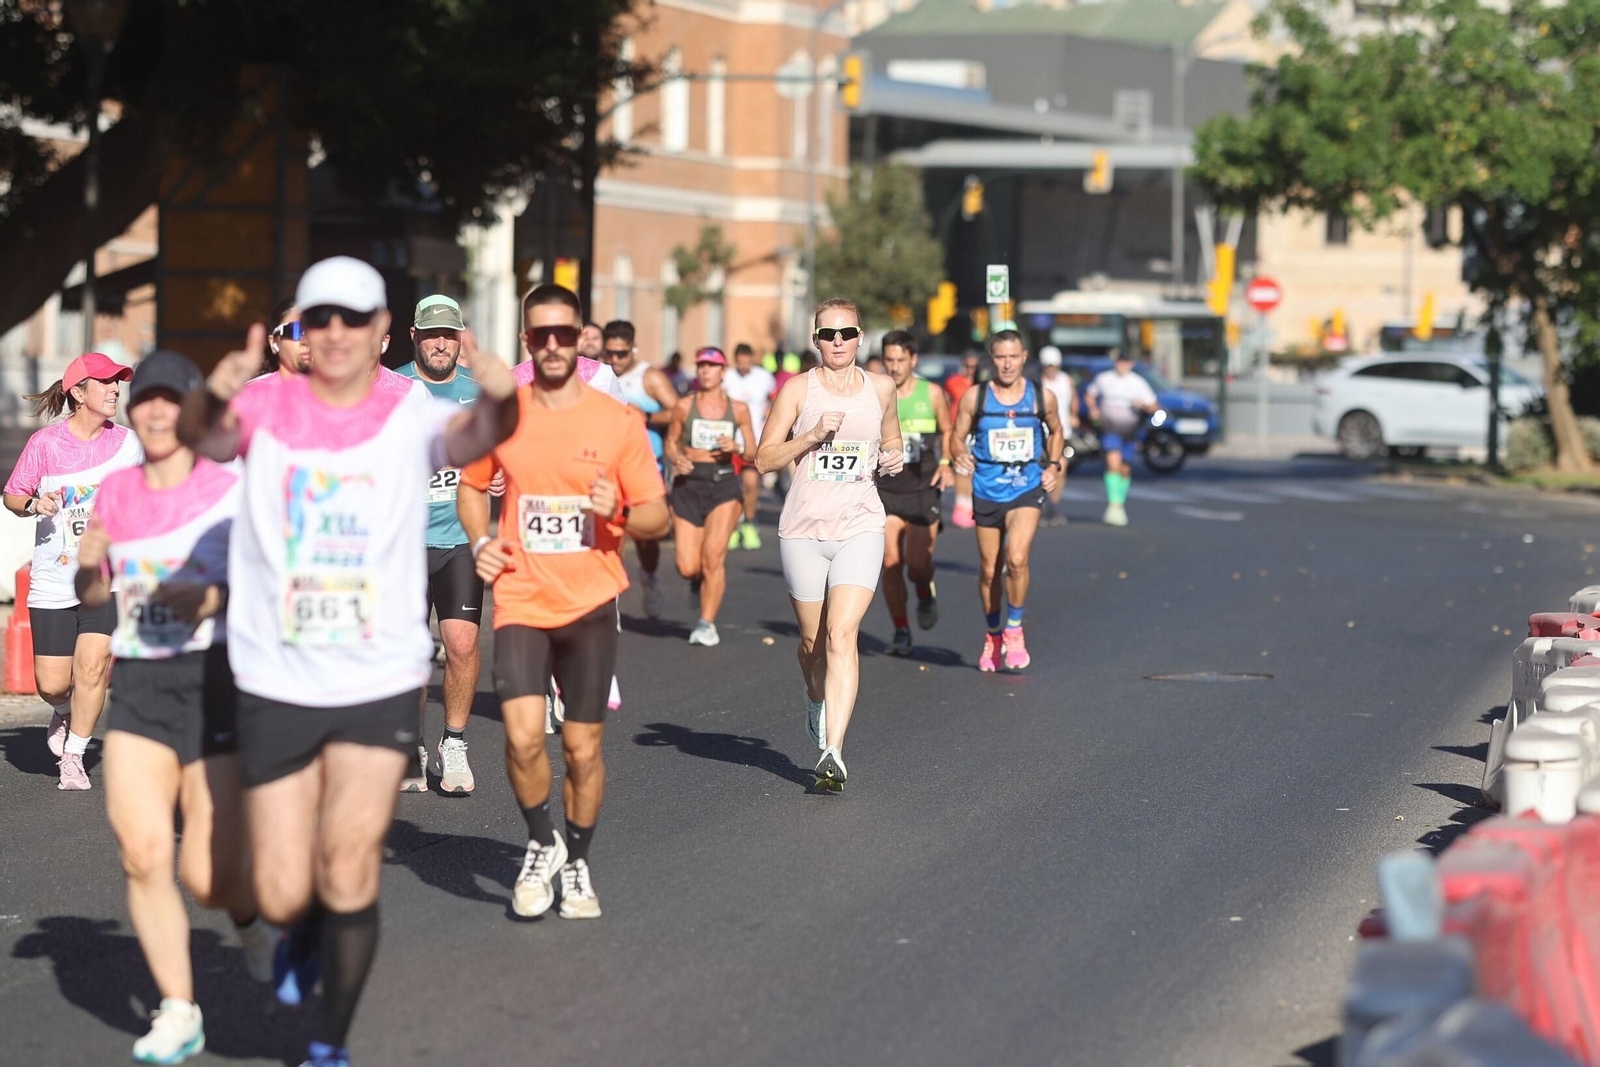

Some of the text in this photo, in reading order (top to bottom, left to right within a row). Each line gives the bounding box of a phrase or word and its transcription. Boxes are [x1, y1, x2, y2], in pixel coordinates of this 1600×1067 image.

[997, 440, 1025, 451] 767
[818, 455, 858, 470] 137
[429, 470, 461, 488] 22
[527, 516, 580, 534] 431
[296, 596, 364, 622] 661
